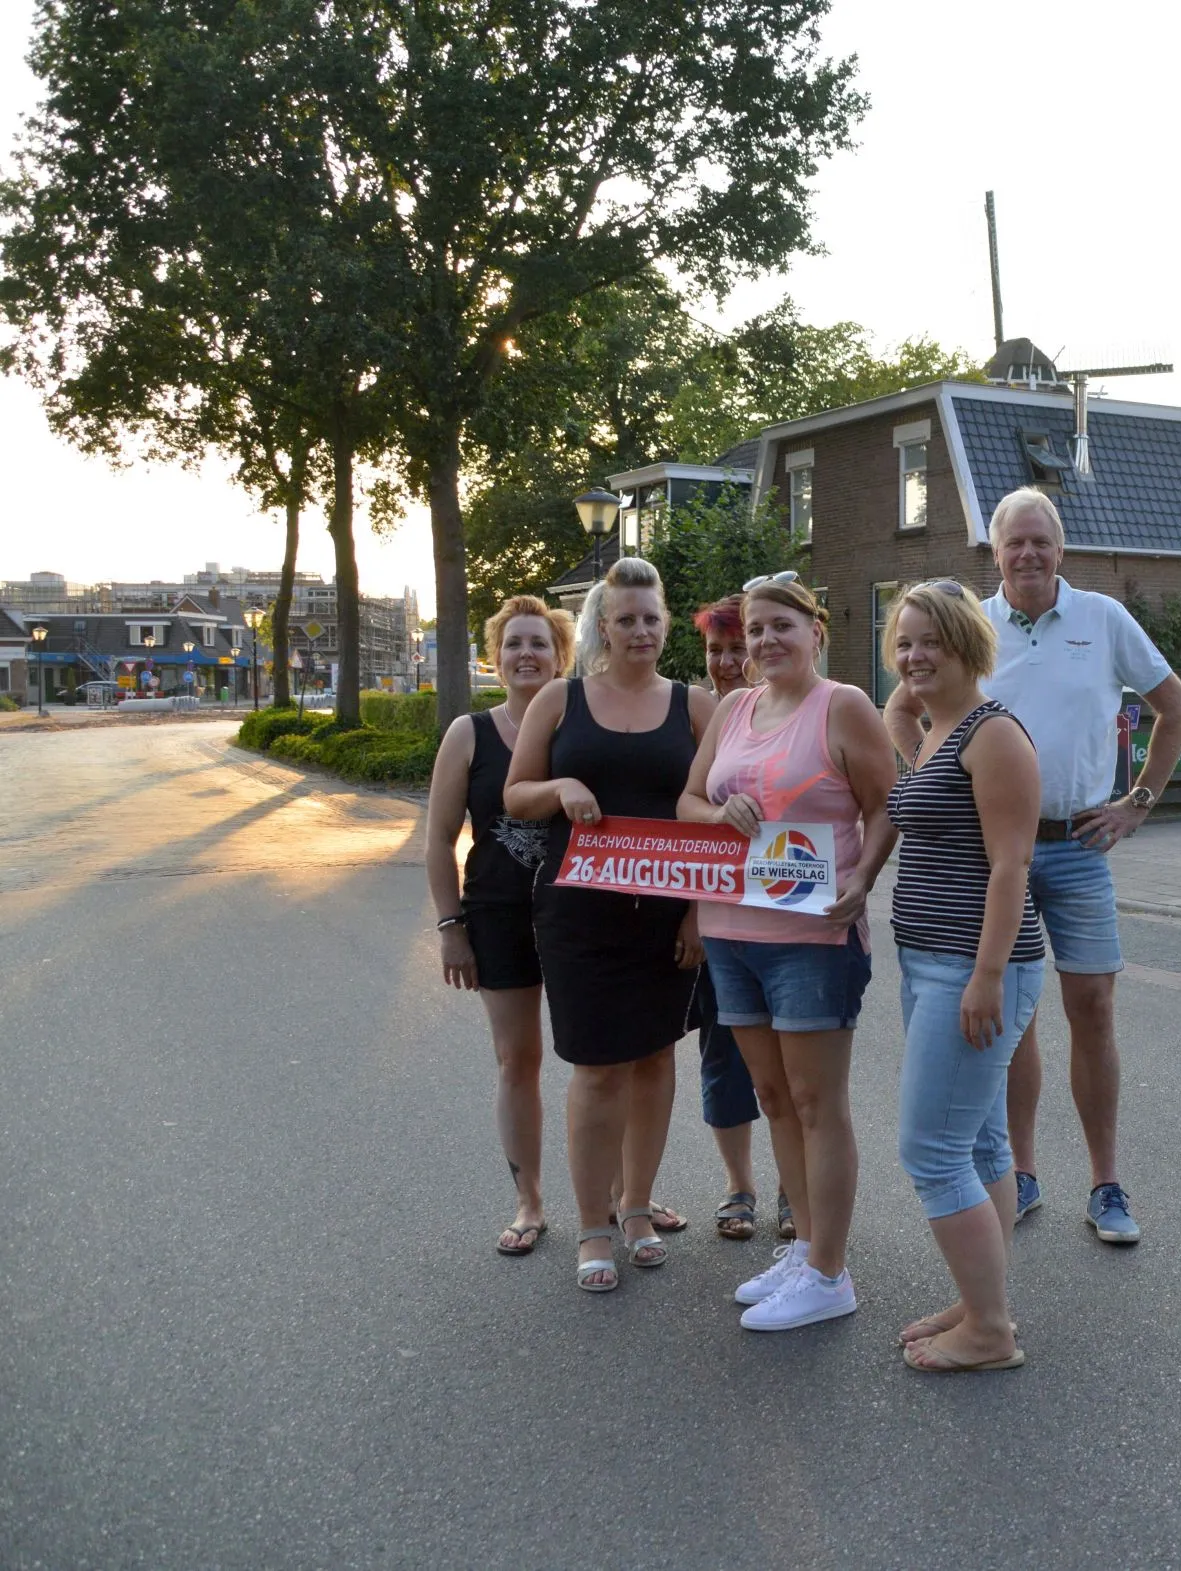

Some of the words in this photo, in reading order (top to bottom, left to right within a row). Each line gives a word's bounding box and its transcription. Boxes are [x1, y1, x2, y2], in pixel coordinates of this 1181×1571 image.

[577, 834, 742, 856] BEACHVOLLEYBALTOERNOOI
[565, 855, 595, 882] 26
[597, 857, 736, 893] AUGUSTUS
[751, 866, 766, 877] DE
[768, 867, 825, 880] WIEKSLAG
